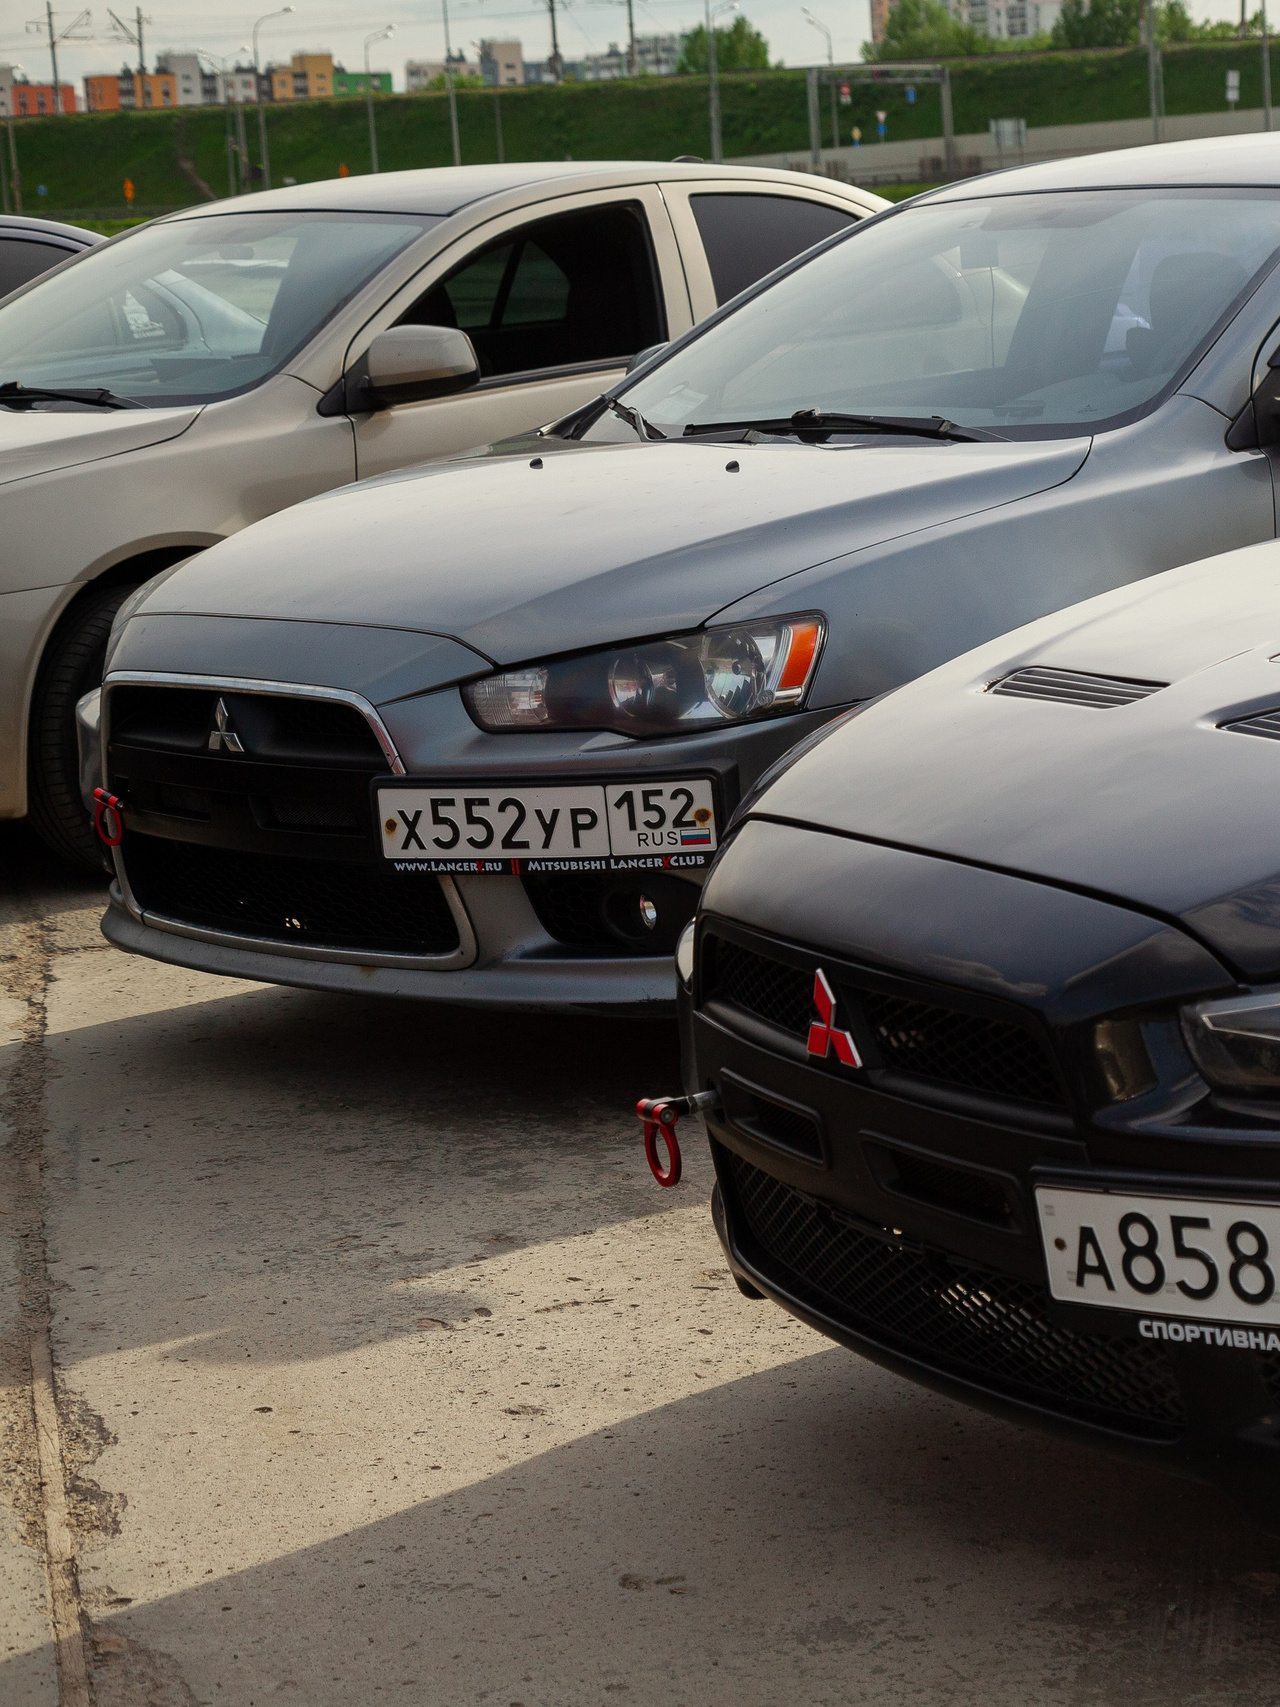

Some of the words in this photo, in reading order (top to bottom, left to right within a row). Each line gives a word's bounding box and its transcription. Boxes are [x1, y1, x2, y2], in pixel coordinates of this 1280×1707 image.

[396, 797, 599, 850] Х552УР
[613, 788, 697, 832] 152
[637, 831, 679, 848] RUS
[527, 860, 606, 871] MITSUBISHI
